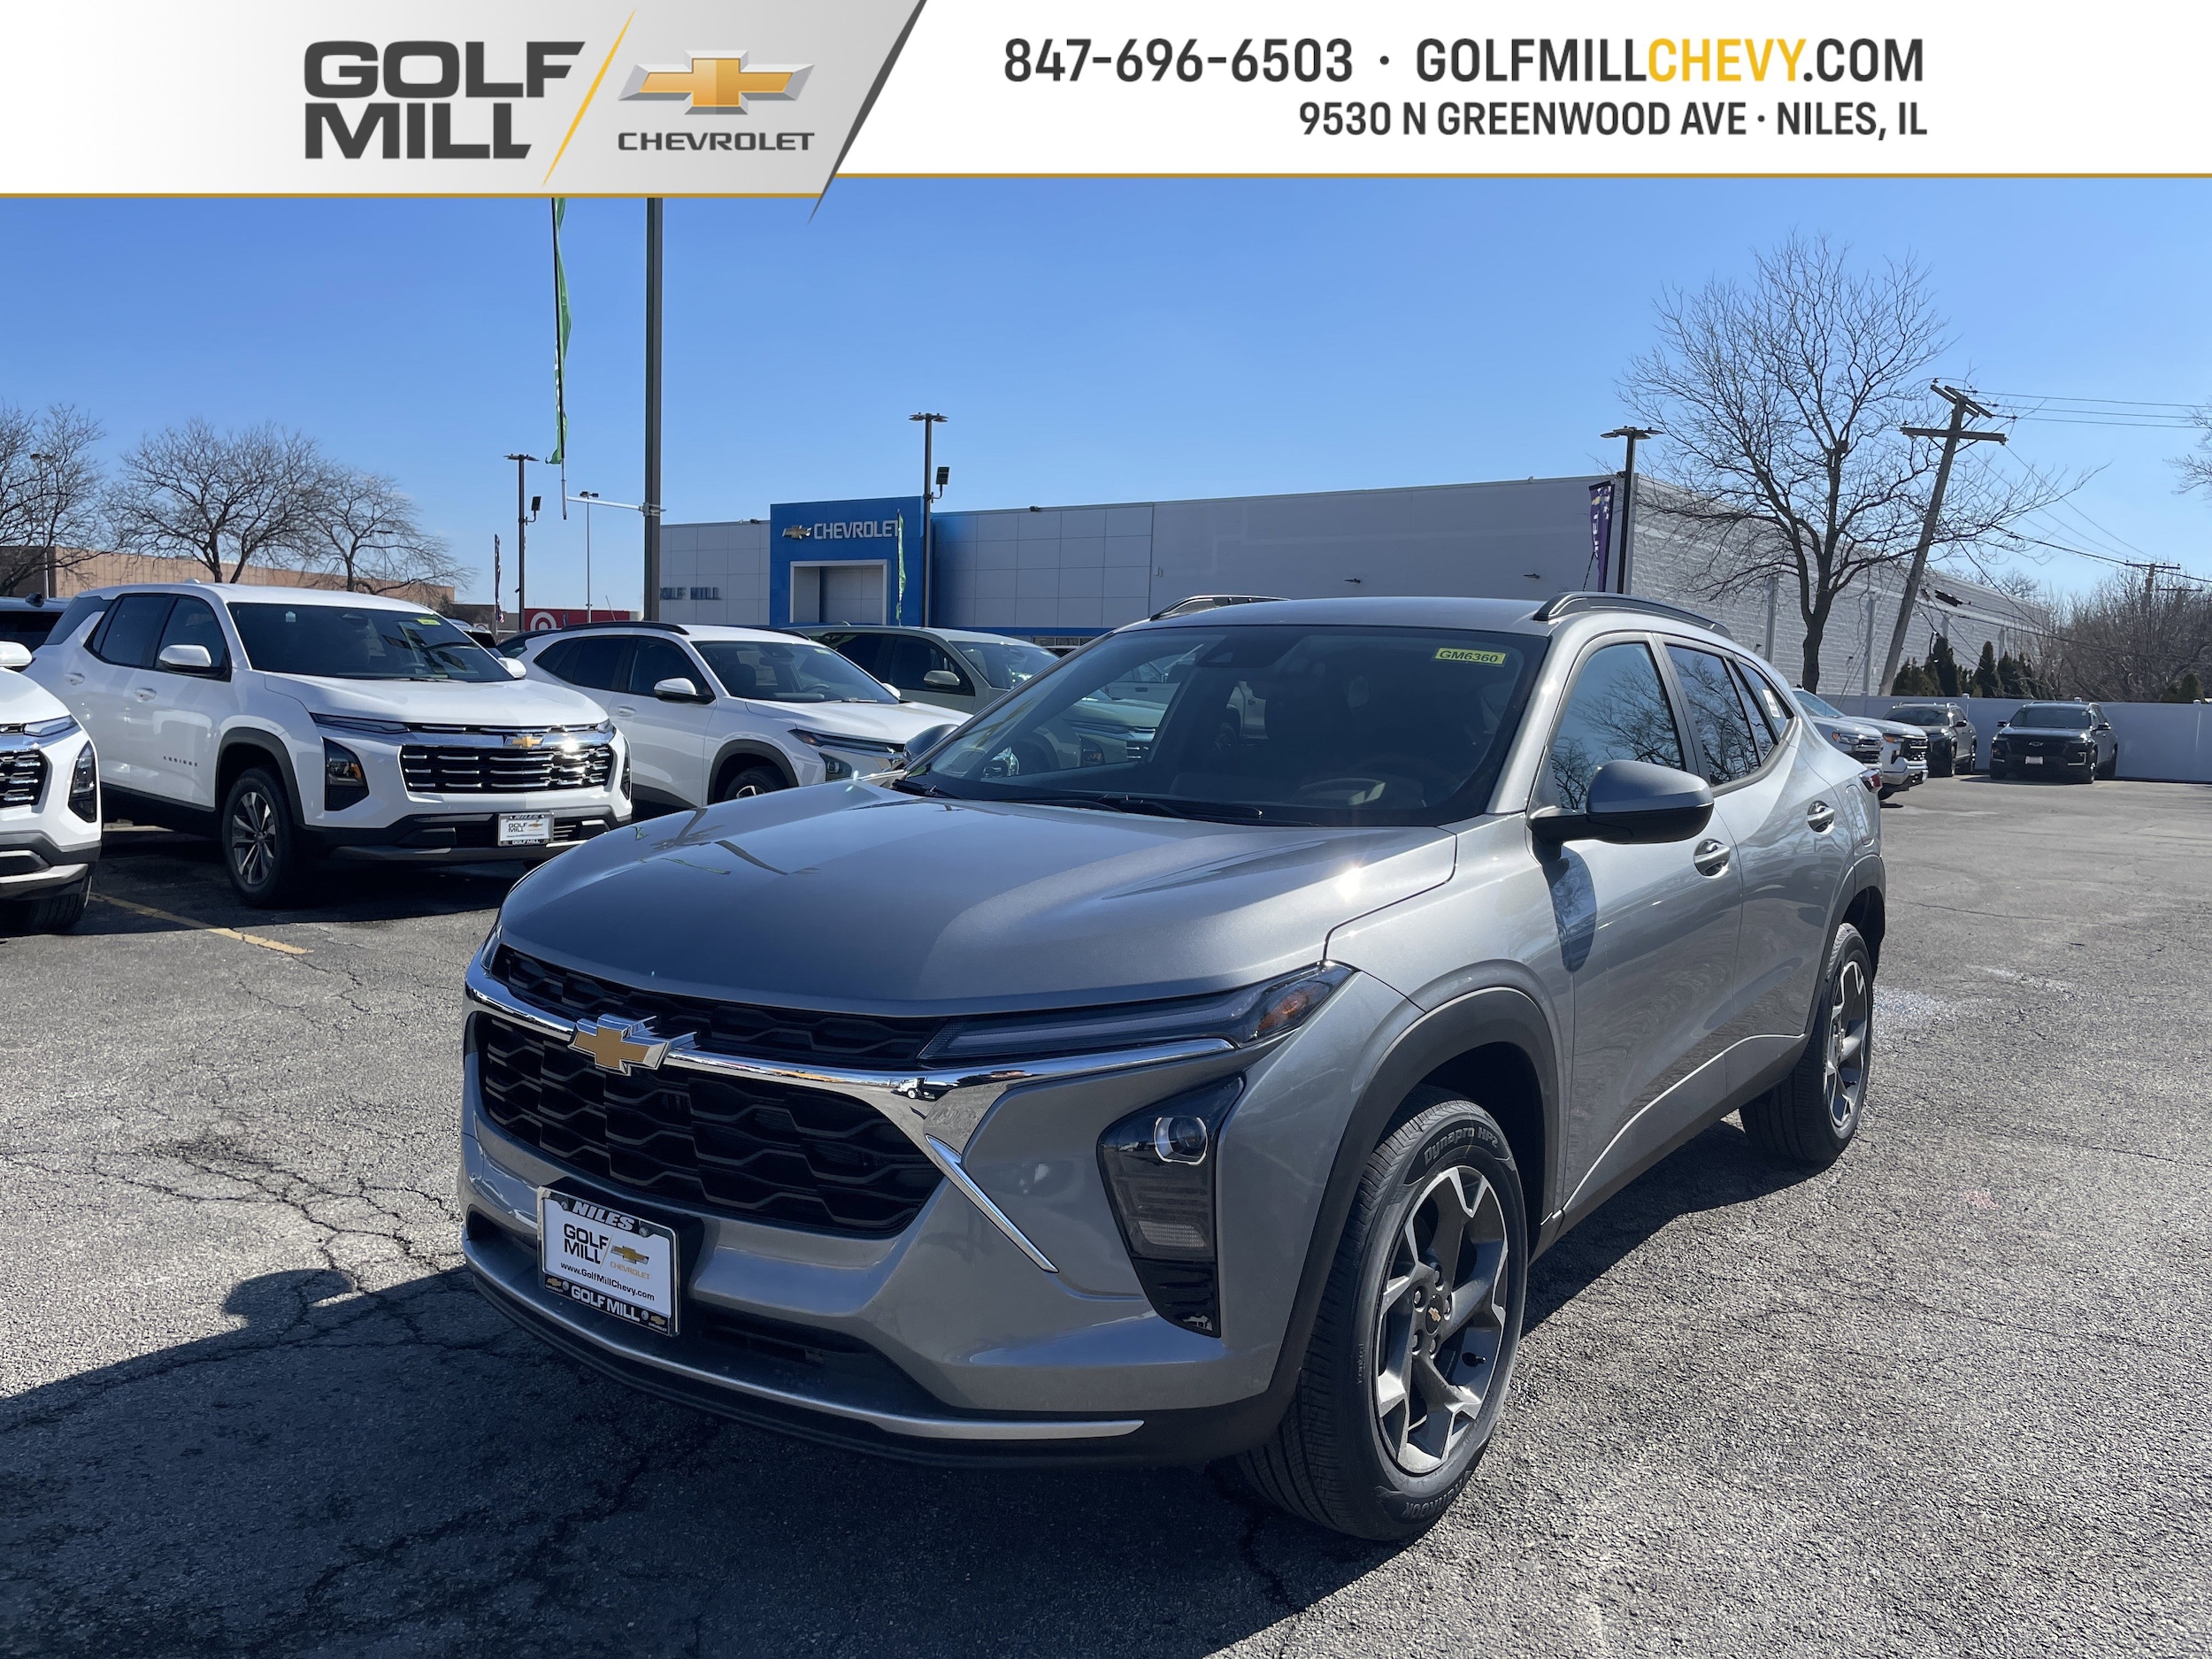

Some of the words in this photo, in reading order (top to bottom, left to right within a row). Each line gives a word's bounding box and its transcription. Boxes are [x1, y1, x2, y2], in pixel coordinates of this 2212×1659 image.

[814, 519, 898, 540] CHEVROLET
[690, 588, 722, 601] MILL
[1440, 650, 1498, 663] GM6360
[1424, 1126, 1475, 1166] Dynapro
[1477, 1126, 1499, 1148] HP2
[572, 1201, 635, 1231] NILES
[564, 1223, 609, 1250] GOLF
[564, 1240, 602, 1265] MILL
[560, 1262, 655, 1301] www.GolfMillChevy.com
[610, 1261, 651, 1280] CHEVROLET
[571, 1285, 606, 1308] GOLF
[606, 1298, 641, 1323] MILL
